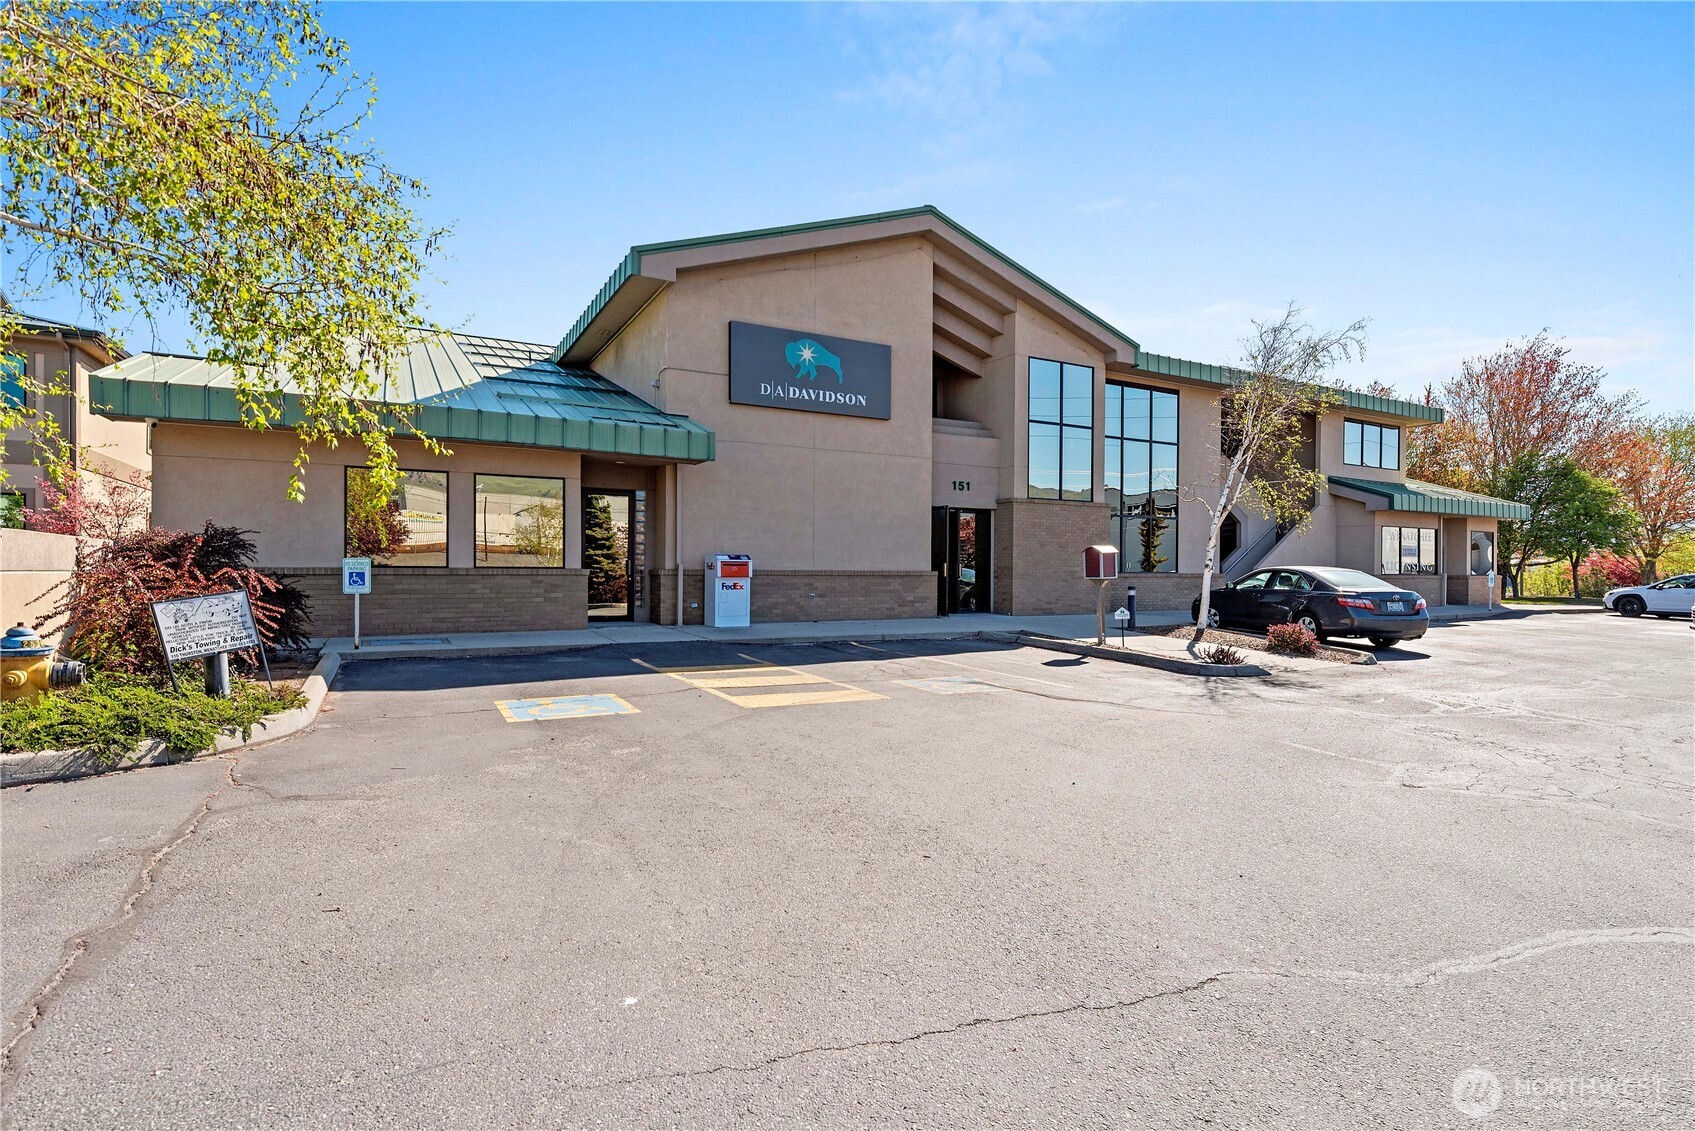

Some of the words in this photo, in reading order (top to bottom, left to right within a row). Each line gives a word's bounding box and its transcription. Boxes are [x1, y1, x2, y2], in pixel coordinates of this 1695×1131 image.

[952, 481, 970, 491] 151
[1390, 530, 1432, 542] WENATCHEE
[1386, 562, 1432, 572] LICENSING
[722, 582, 744, 590] FedEx
[170, 643, 193, 653] Dick's
[195, 638, 221, 649] Towing
[230, 632, 254, 642] Repair
